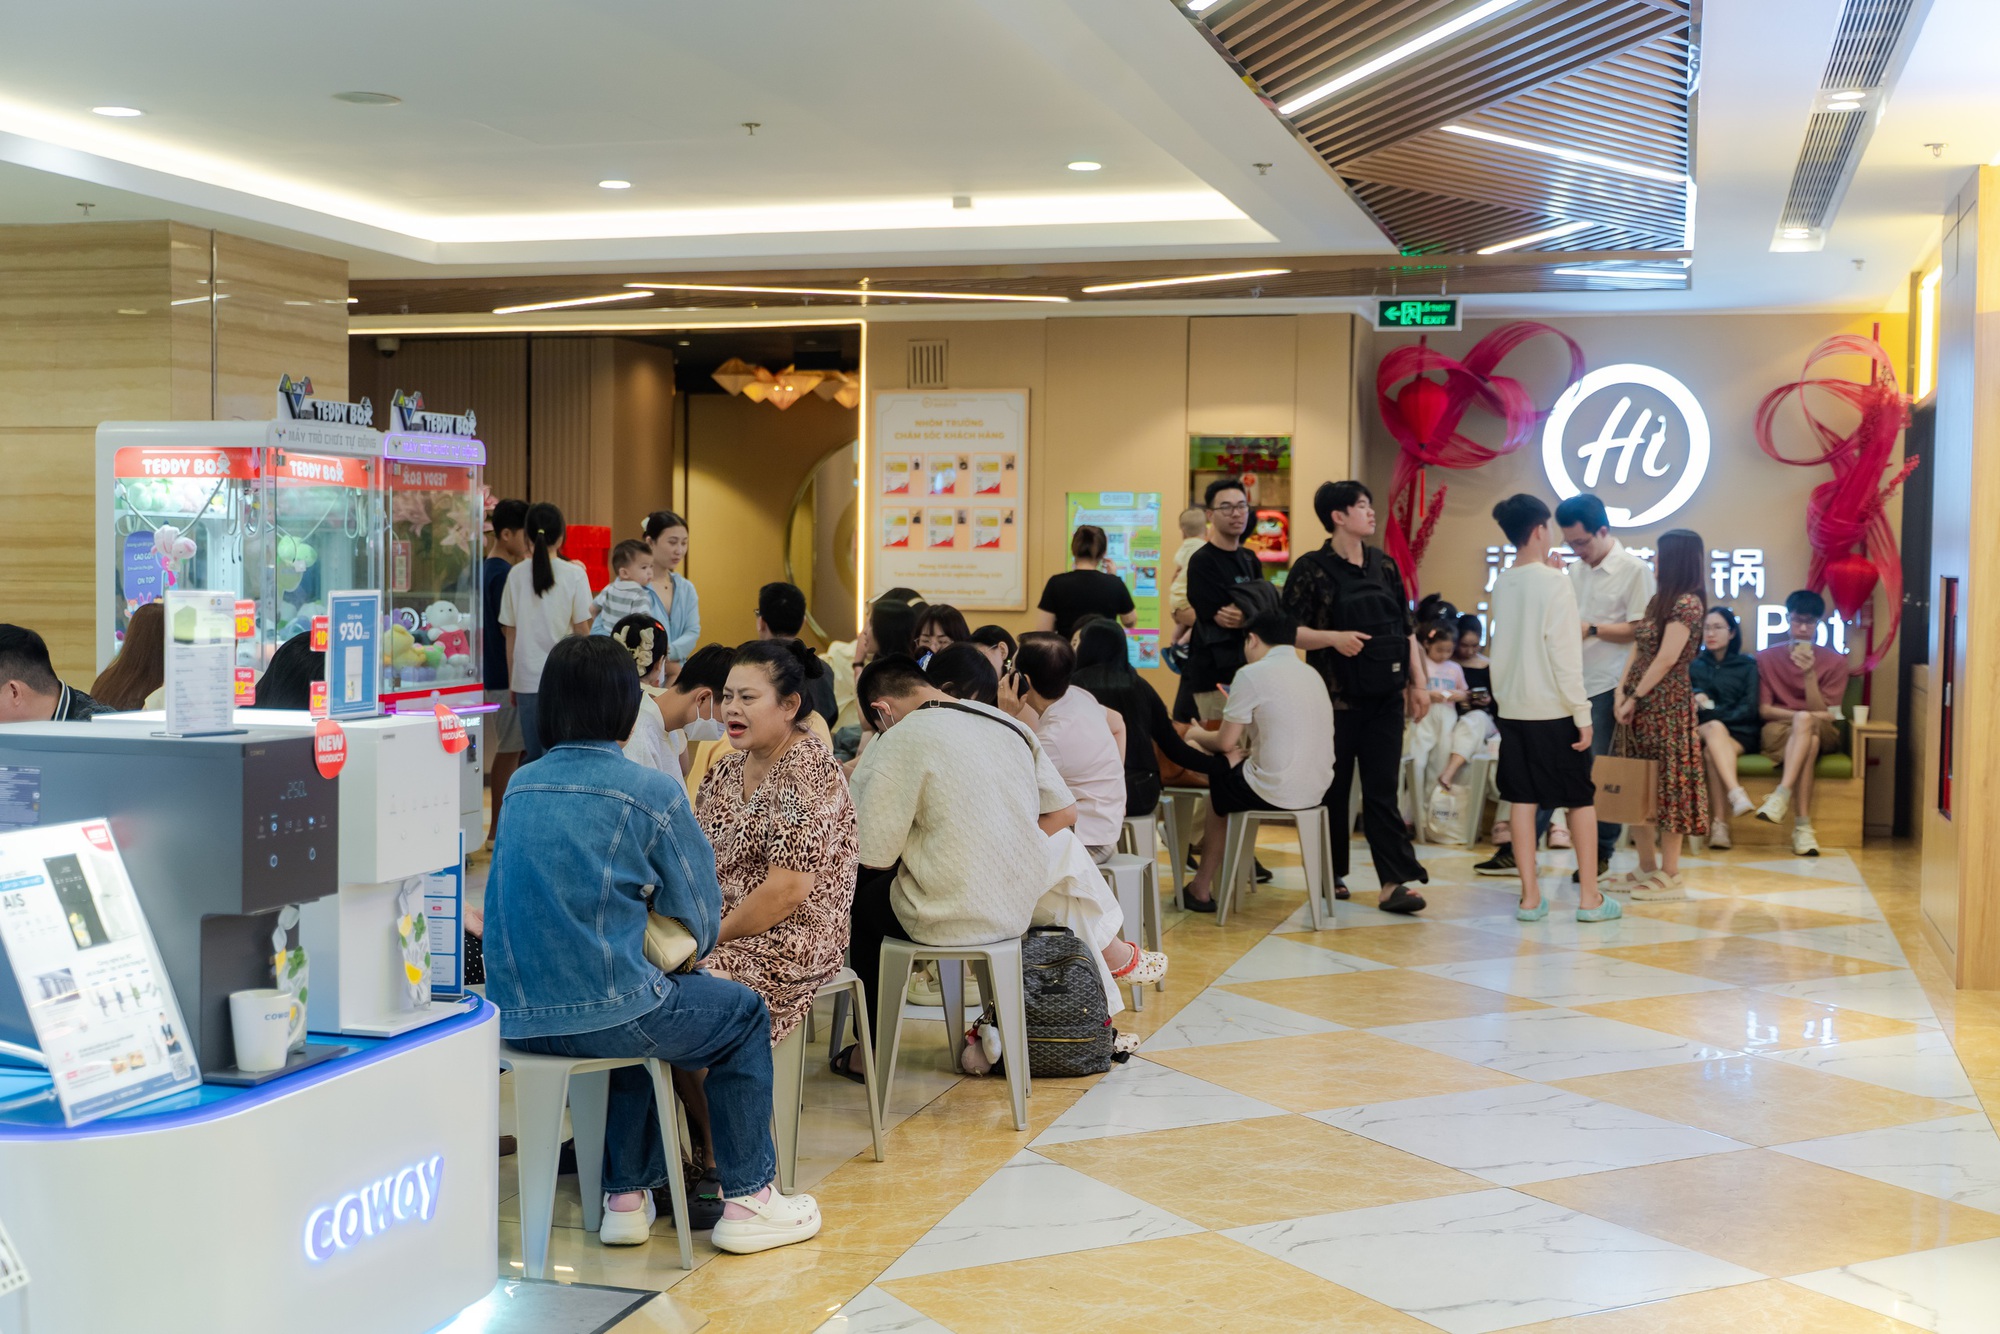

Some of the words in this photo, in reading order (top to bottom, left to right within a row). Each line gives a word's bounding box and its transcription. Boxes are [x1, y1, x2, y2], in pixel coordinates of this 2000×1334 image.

[1422, 315, 1448, 325] EXIT
[314, 401, 348, 423] TEDDY
[424, 415, 454, 434] TEDDY
[1577, 397, 1670, 487] Hi
[142, 458, 190, 475] TEDDY
[194, 454, 230, 475] BOX
[289, 460, 322, 479] TEDDY
[323, 461, 344, 482] BOX
[340, 621, 363, 641] 930
[318, 734, 344, 752] NEW
[318, 753, 344, 764] PRODUCT
[304, 1156, 444, 1260] COWAY
